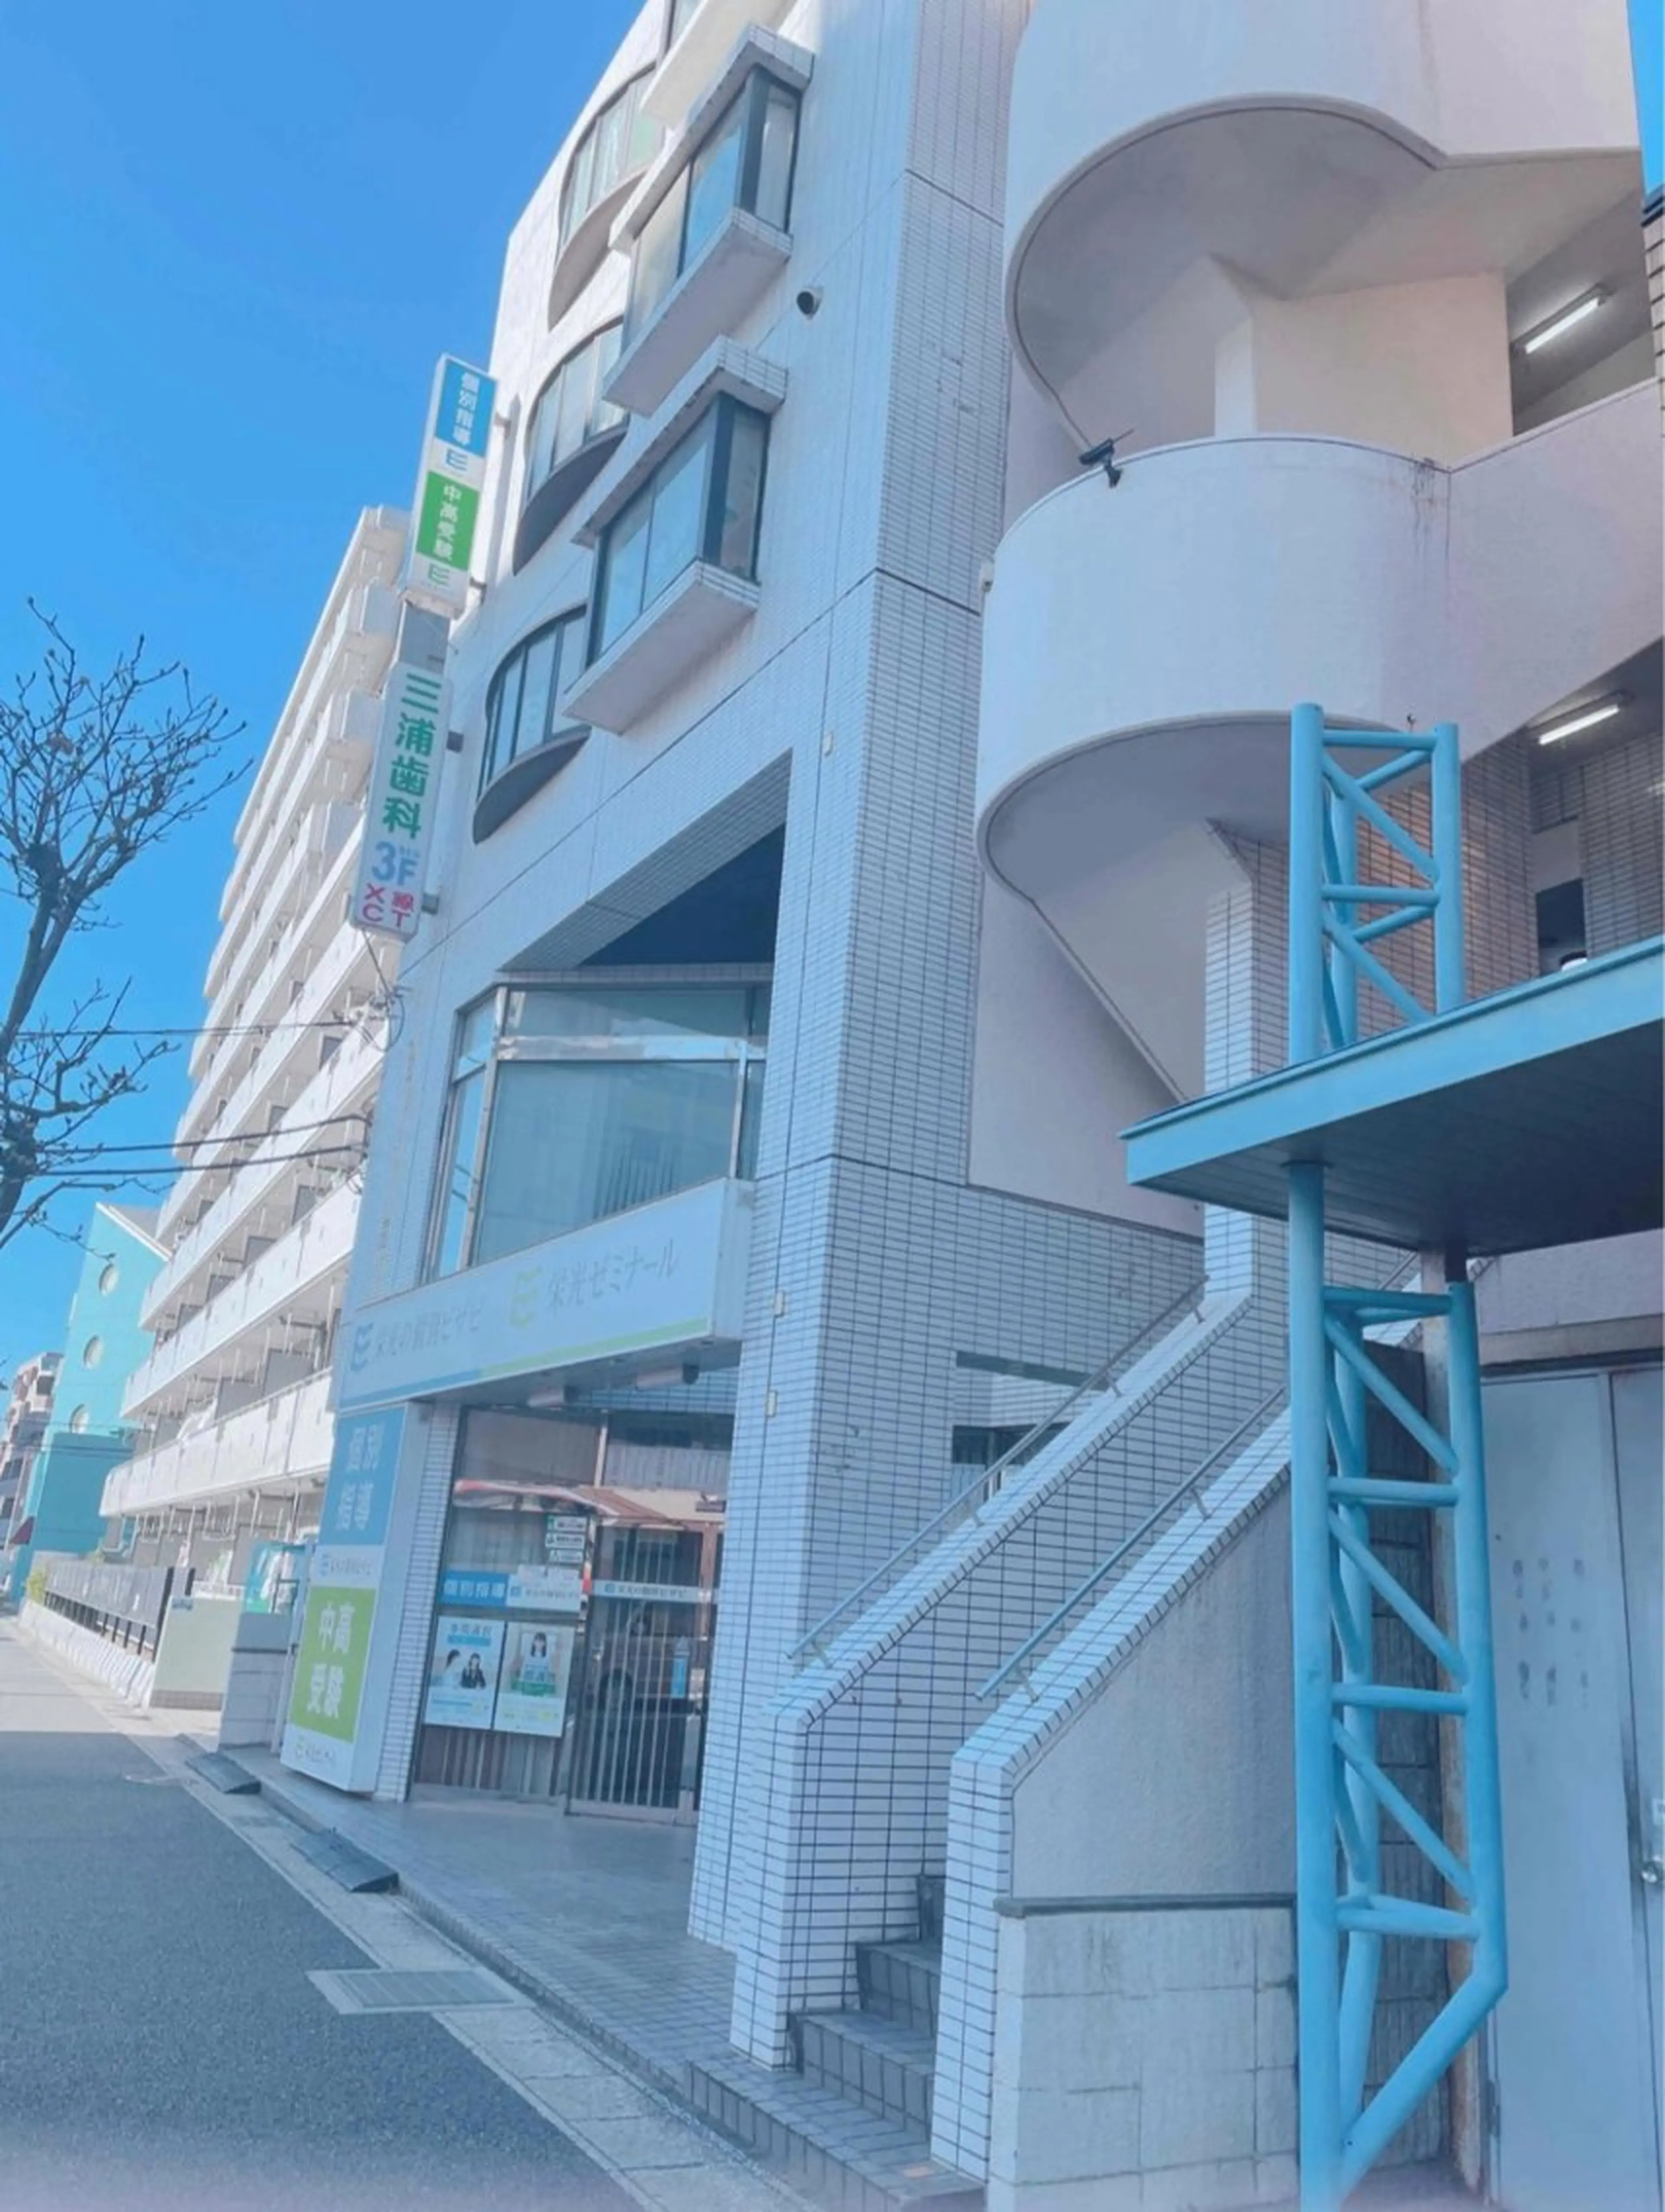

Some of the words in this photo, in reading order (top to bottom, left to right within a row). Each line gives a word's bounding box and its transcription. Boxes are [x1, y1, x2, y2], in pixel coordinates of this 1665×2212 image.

[434, 484, 461, 561] 中高受験
[382, 672, 442, 839] 三浦歯科
[371, 841, 419, 886] 3F
[319, 1600, 356, 1654] 中高
[307, 1663, 344, 1720] 受験
